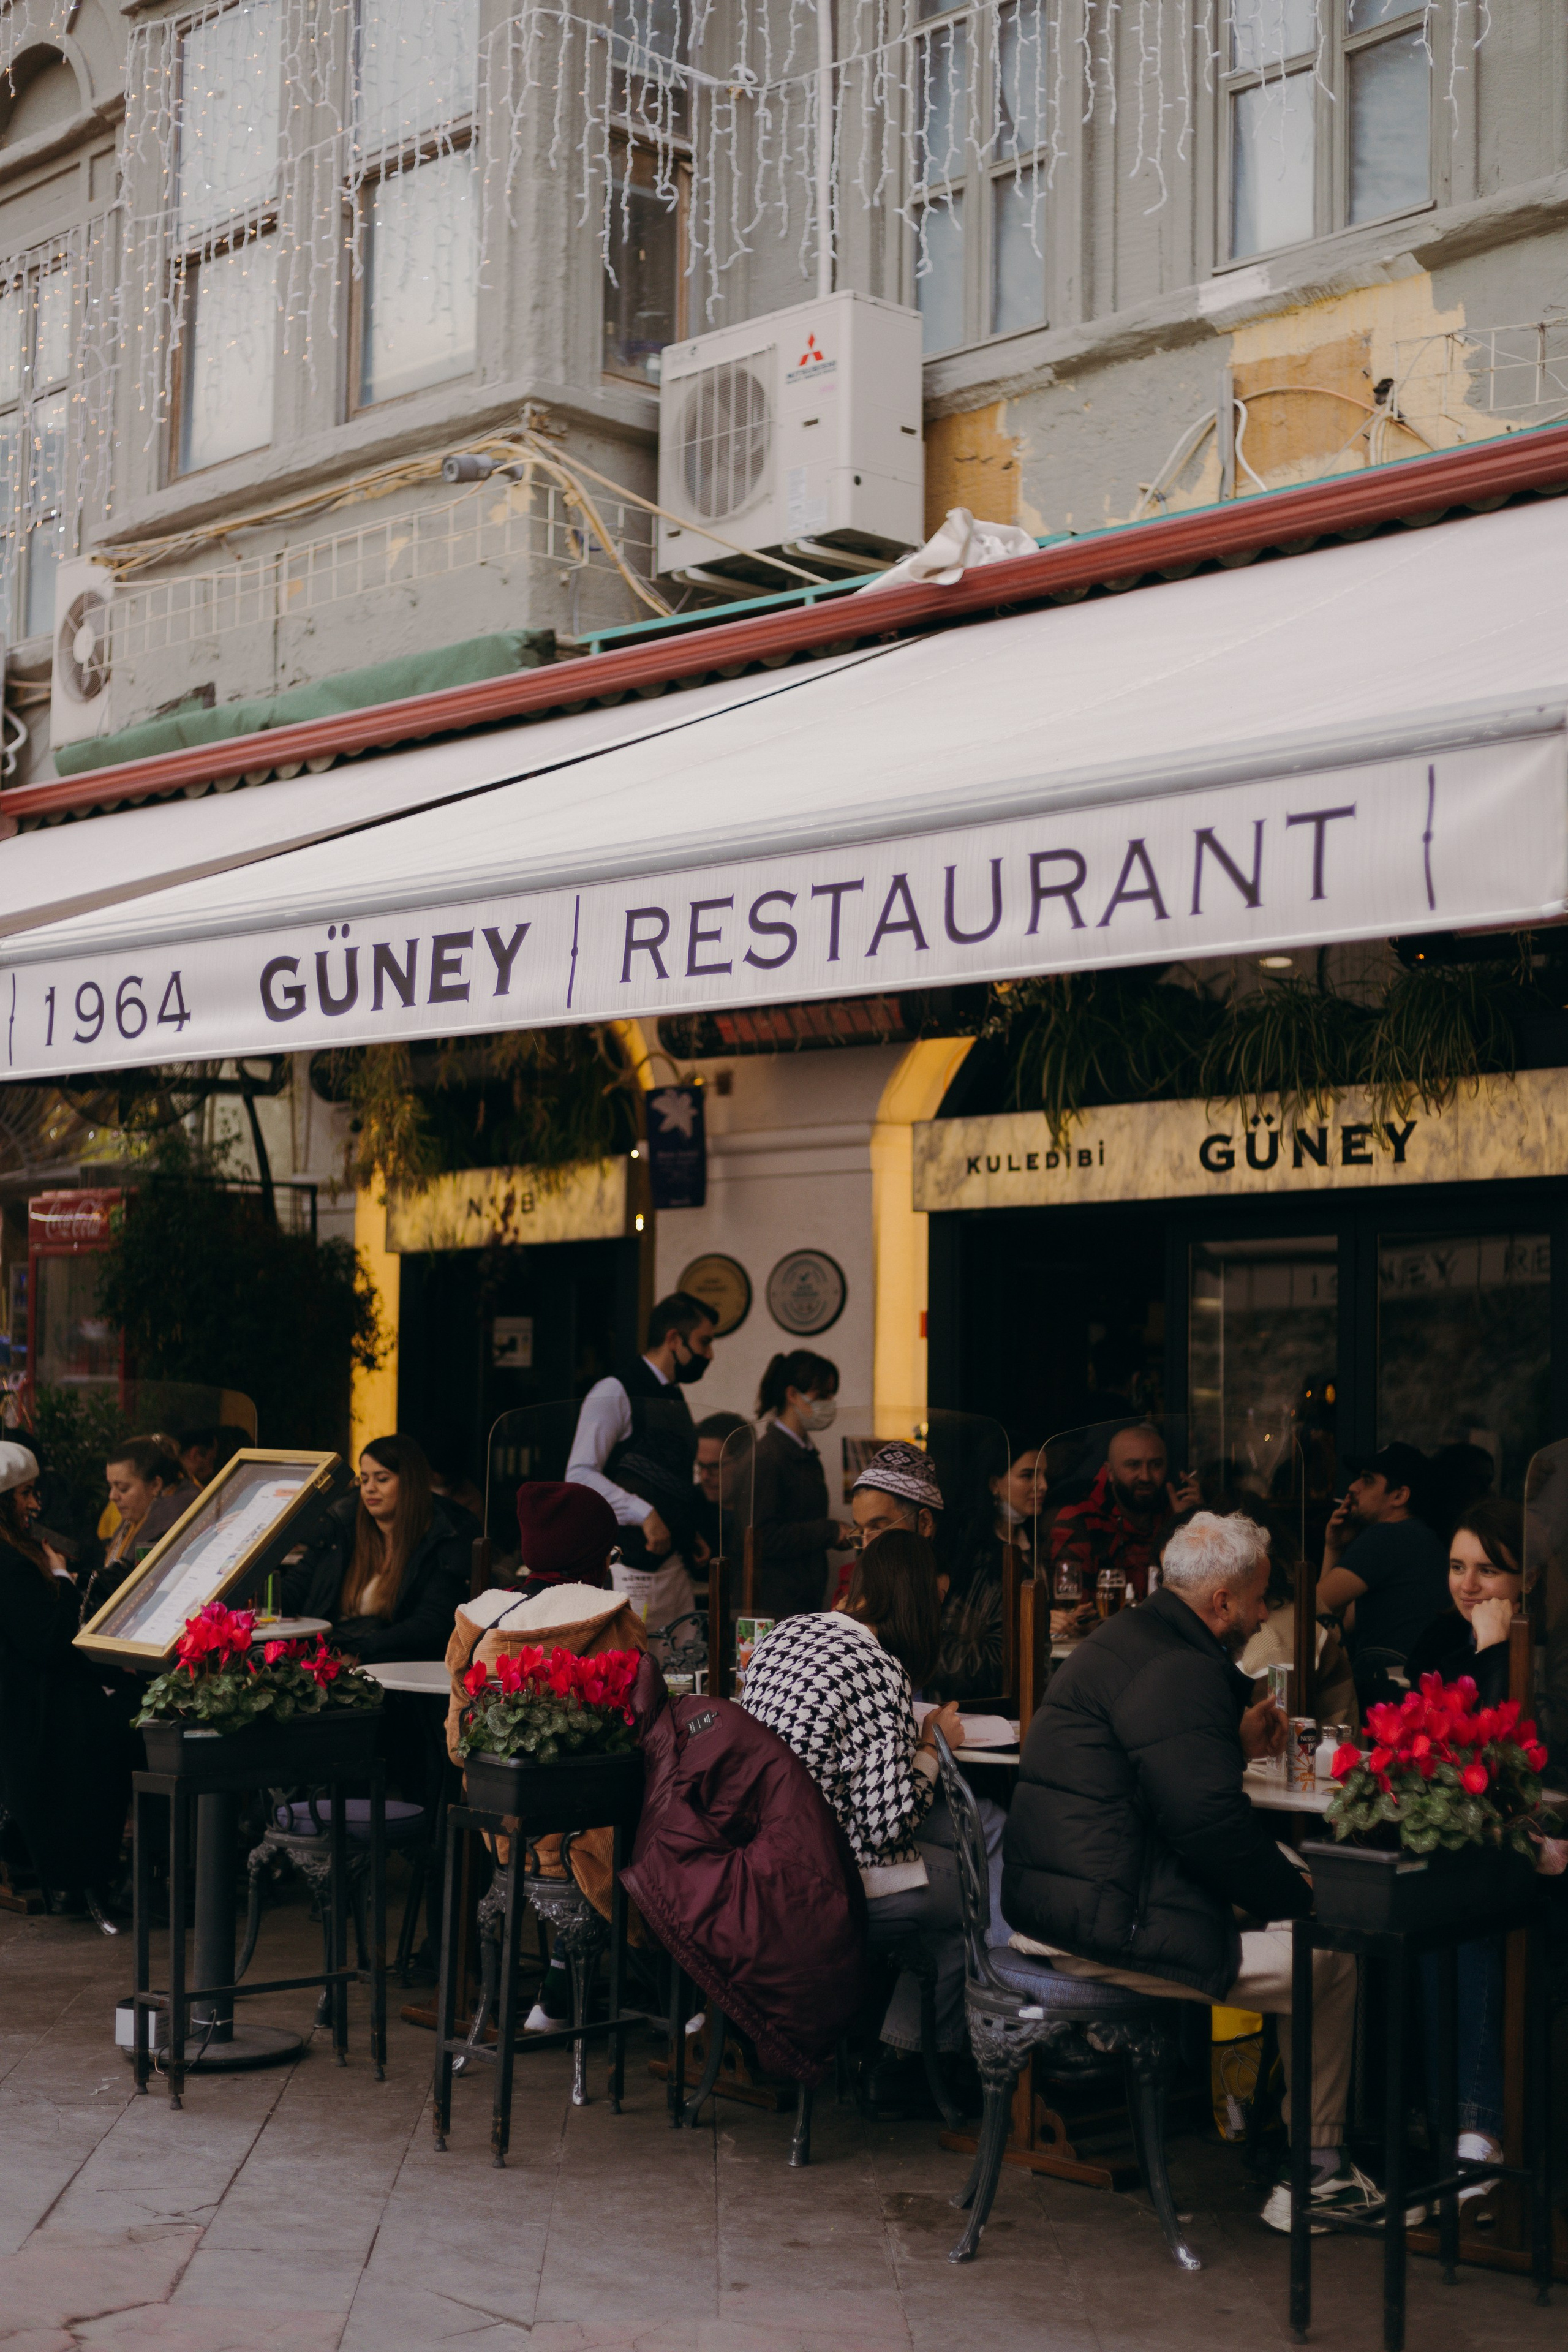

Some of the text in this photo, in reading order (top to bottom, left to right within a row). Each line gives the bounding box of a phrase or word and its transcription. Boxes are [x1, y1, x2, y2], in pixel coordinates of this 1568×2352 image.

[44, 801, 1357, 1047] 1964 GÜNEY RESTAURANT
[967, 1114, 1418, 1175] KULEDİBİ GÜNEY
